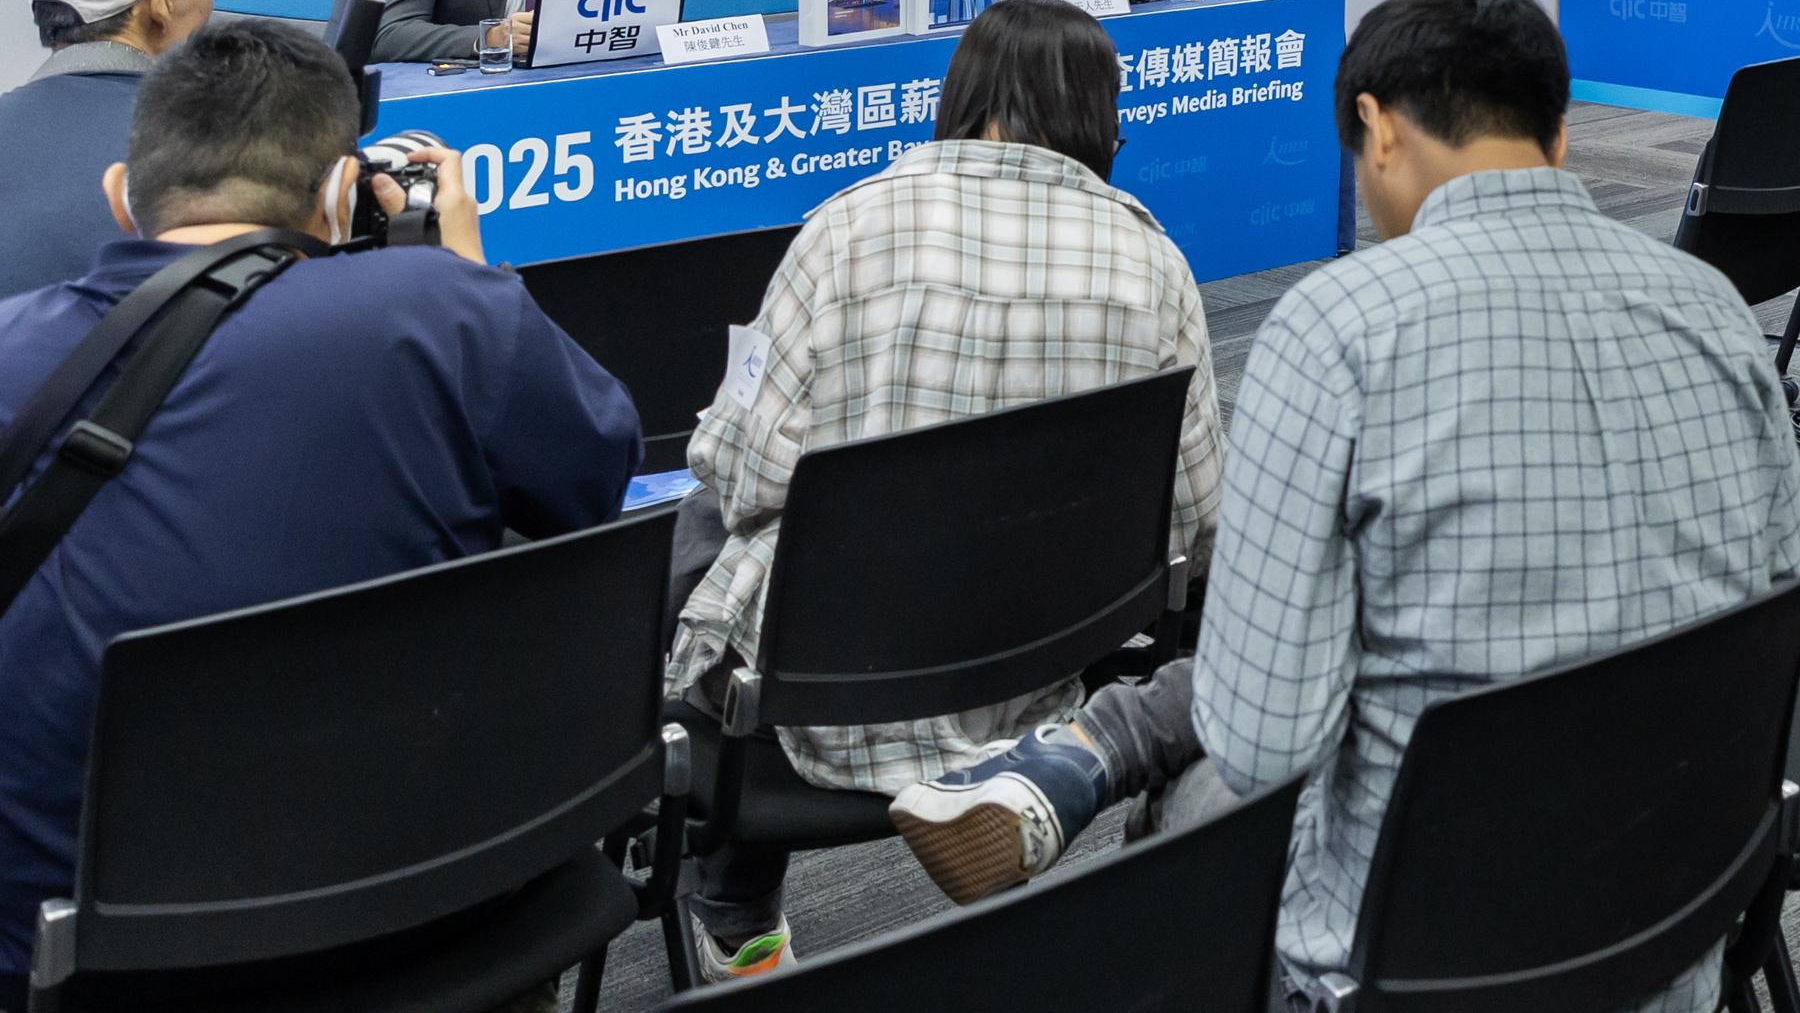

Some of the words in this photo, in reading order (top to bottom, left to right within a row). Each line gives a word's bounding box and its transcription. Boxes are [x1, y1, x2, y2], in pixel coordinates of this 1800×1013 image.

[1649, 0, 1688, 24] 中智
[574, 24, 641, 54] 中智
[672, 28, 690, 38] Mr
[691, 22, 721, 35] David
[722, 20, 749, 32] Chen
[614, 172, 687, 202] Hong
[693, 160, 760, 190] Kong
[765, 157, 786, 179] &
[790, 144, 882, 176] Greater
[1116, 98, 1168, 124] rveys
[1172, 89, 1228, 116] Media
[1231, 79, 1305, 107] Briefing
[461, 131, 595, 216] 025
